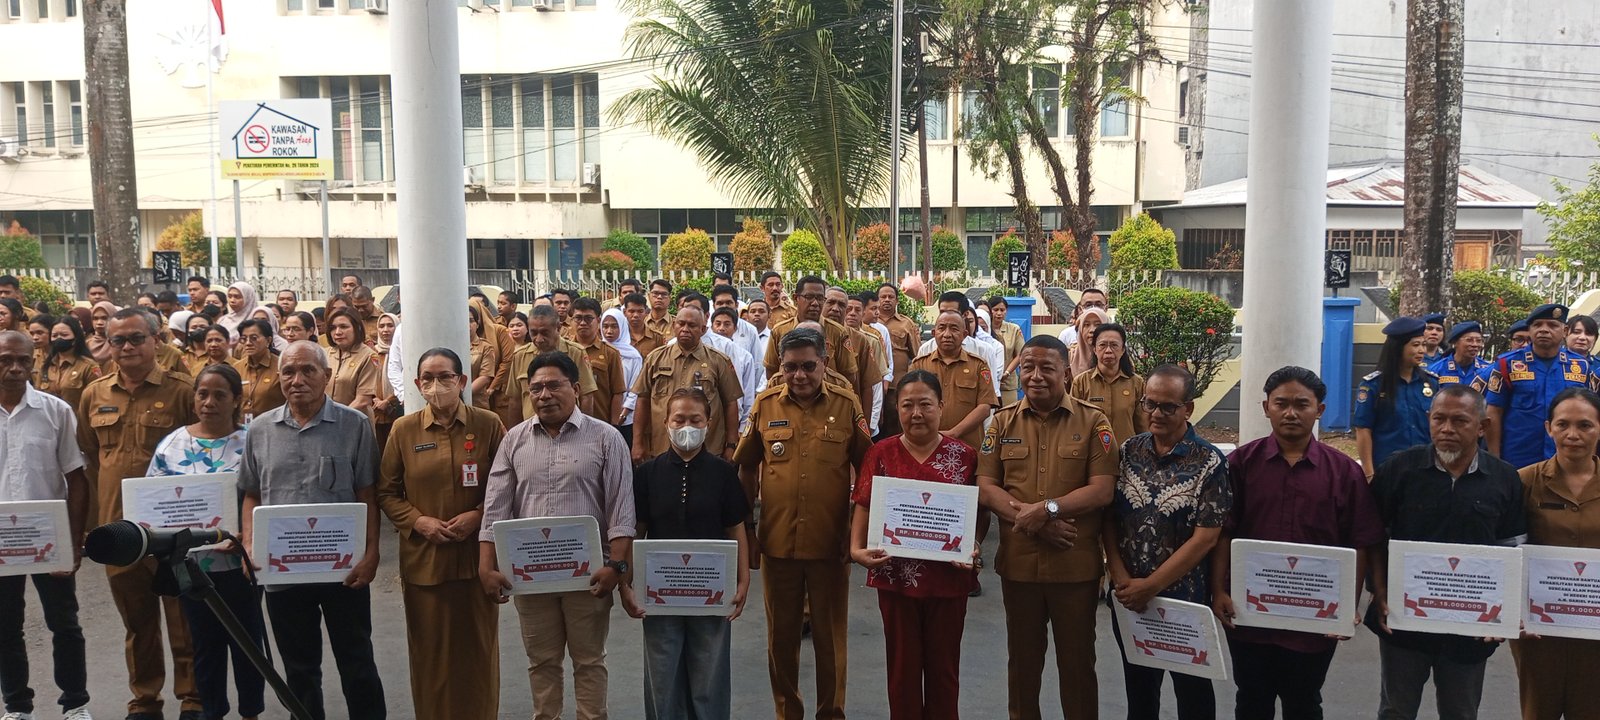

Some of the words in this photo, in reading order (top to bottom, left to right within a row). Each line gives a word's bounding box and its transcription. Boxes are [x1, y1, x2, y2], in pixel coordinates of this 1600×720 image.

[271, 125, 306, 134] KAWASAN
[272, 136, 295, 144] TANPA
[272, 147, 298, 156] ROKOK
[912, 531, 946, 539] 15.000.000
[1280, 597, 1320, 606] 15.000.000
[1440, 600, 1482, 609] 15.000.000
